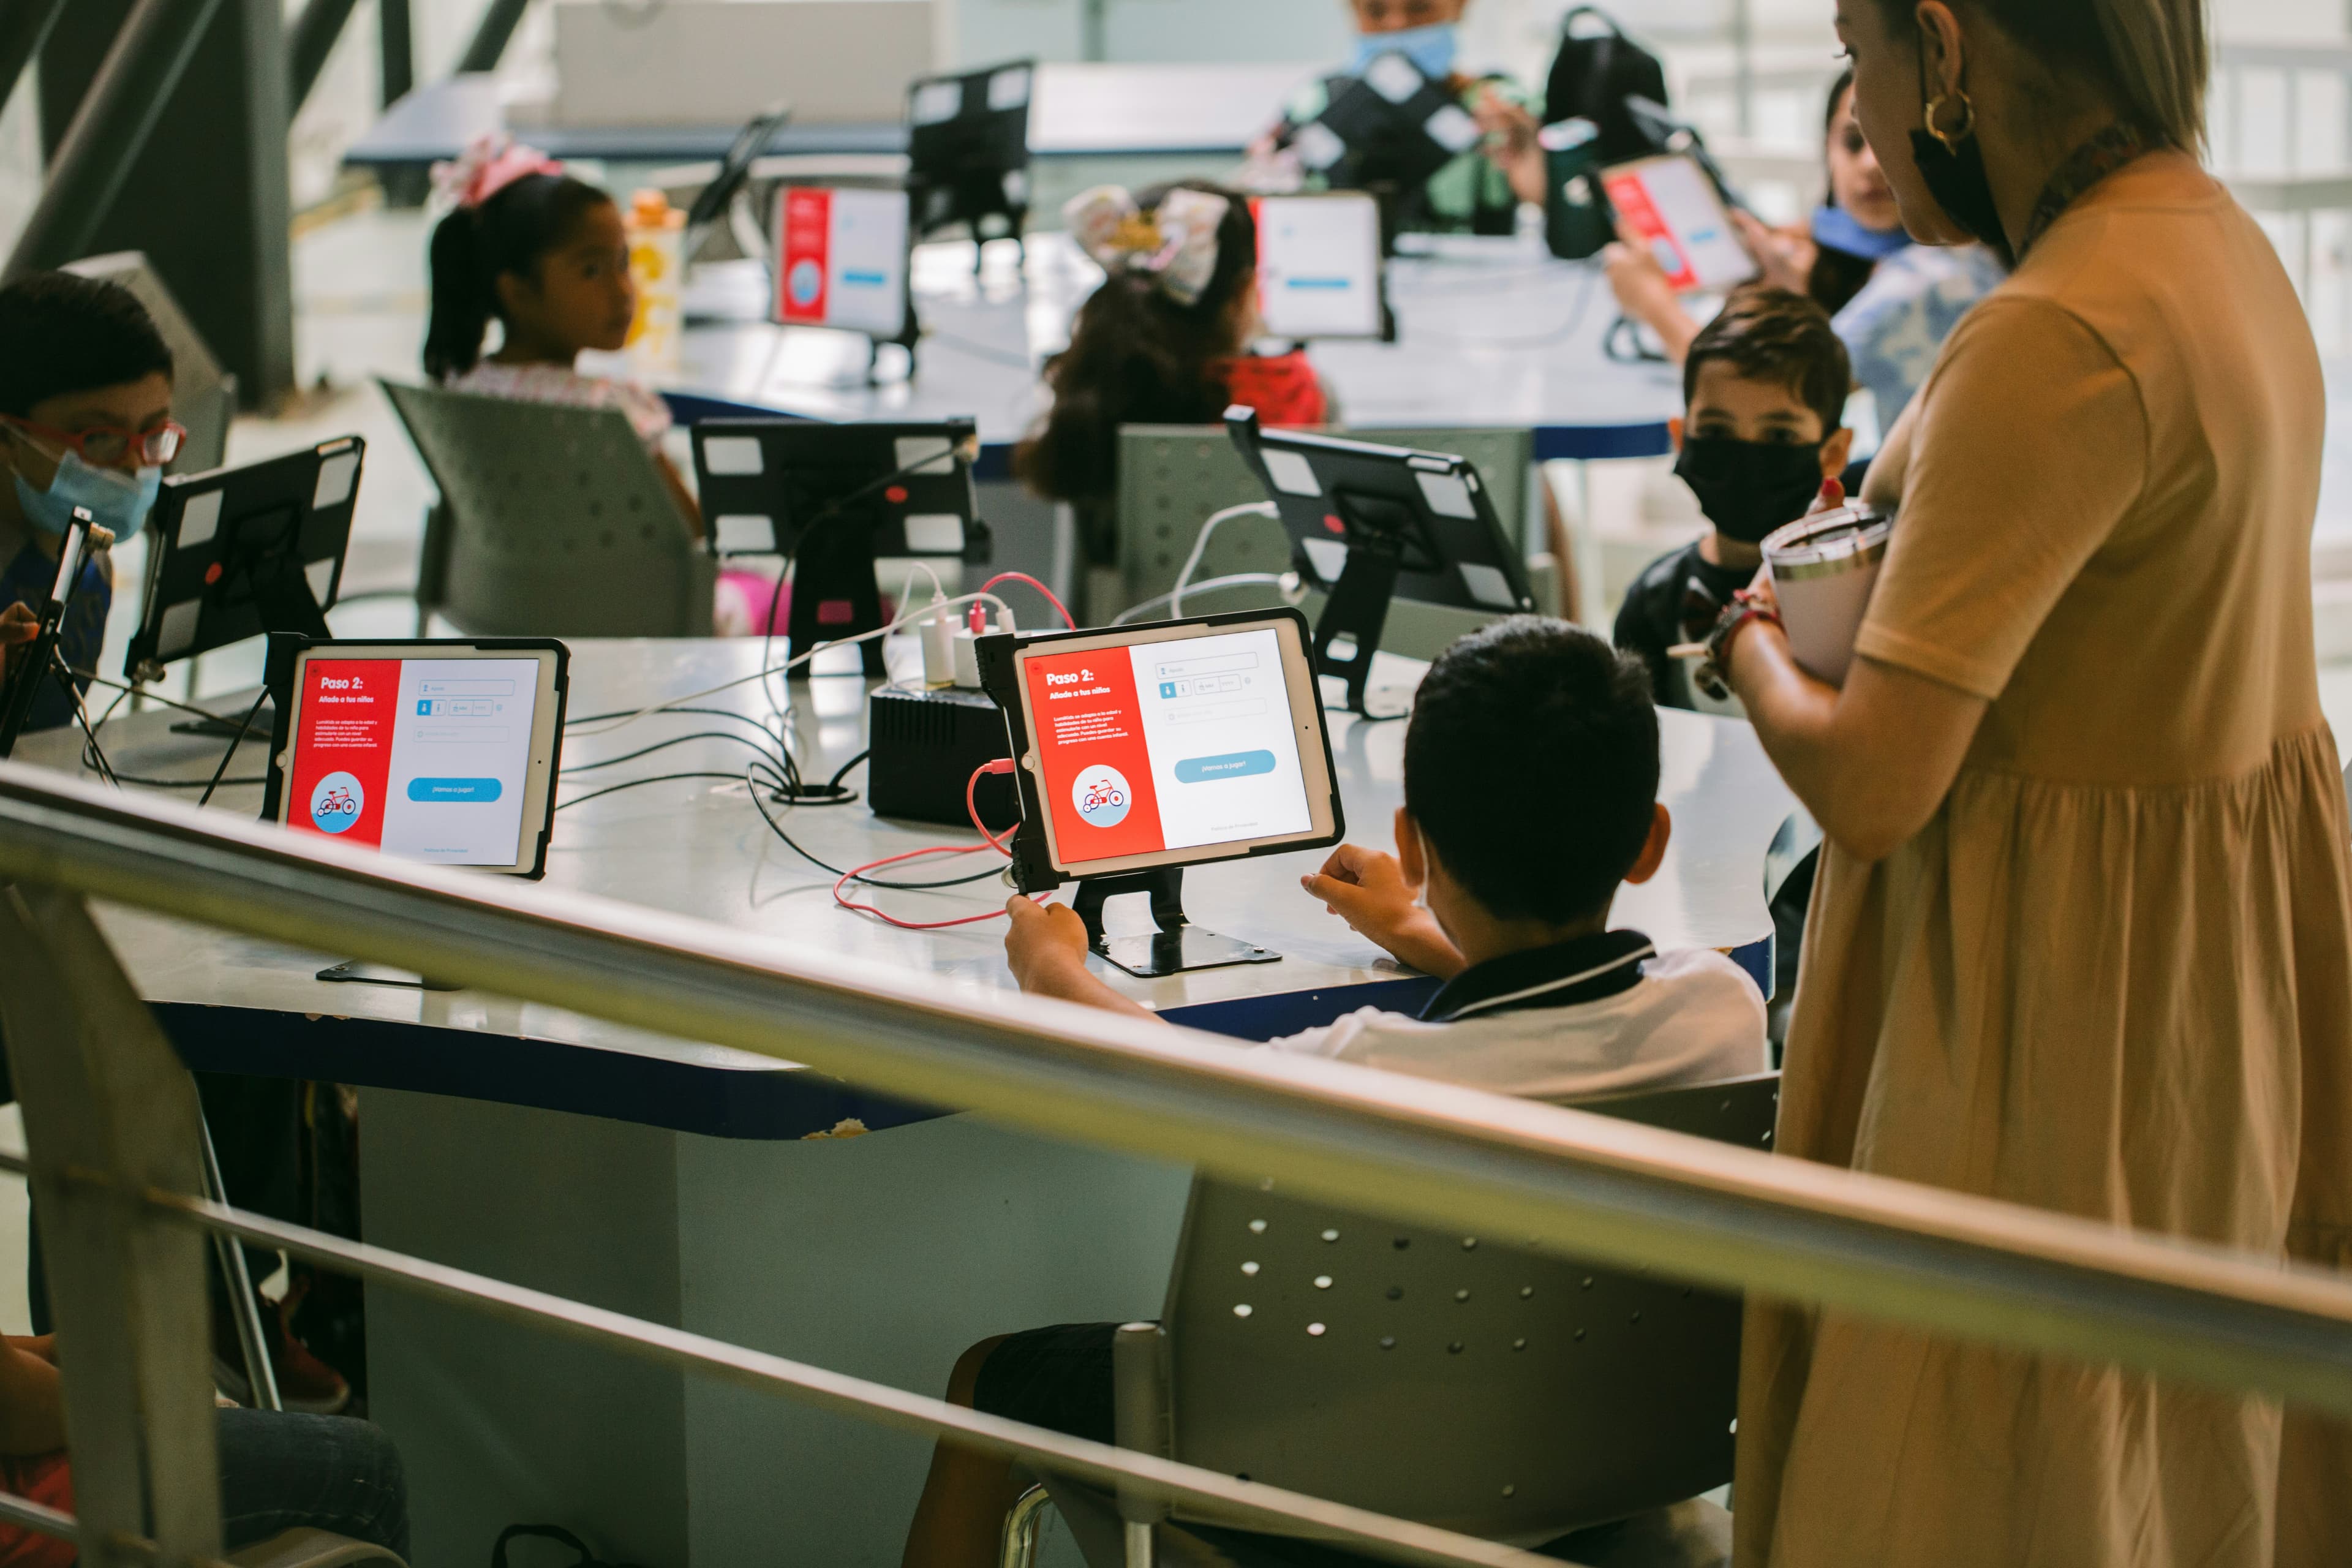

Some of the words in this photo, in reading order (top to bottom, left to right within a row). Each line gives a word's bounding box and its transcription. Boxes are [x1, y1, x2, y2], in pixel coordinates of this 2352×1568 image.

[320, 676, 349, 689] Paso
[352, 676, 363, 689] 2:
[1046, 673, 1079, 686] Paso
[1080, 669, 1095, 682] 2:
[1049, 690, 1072, 699] Añade
